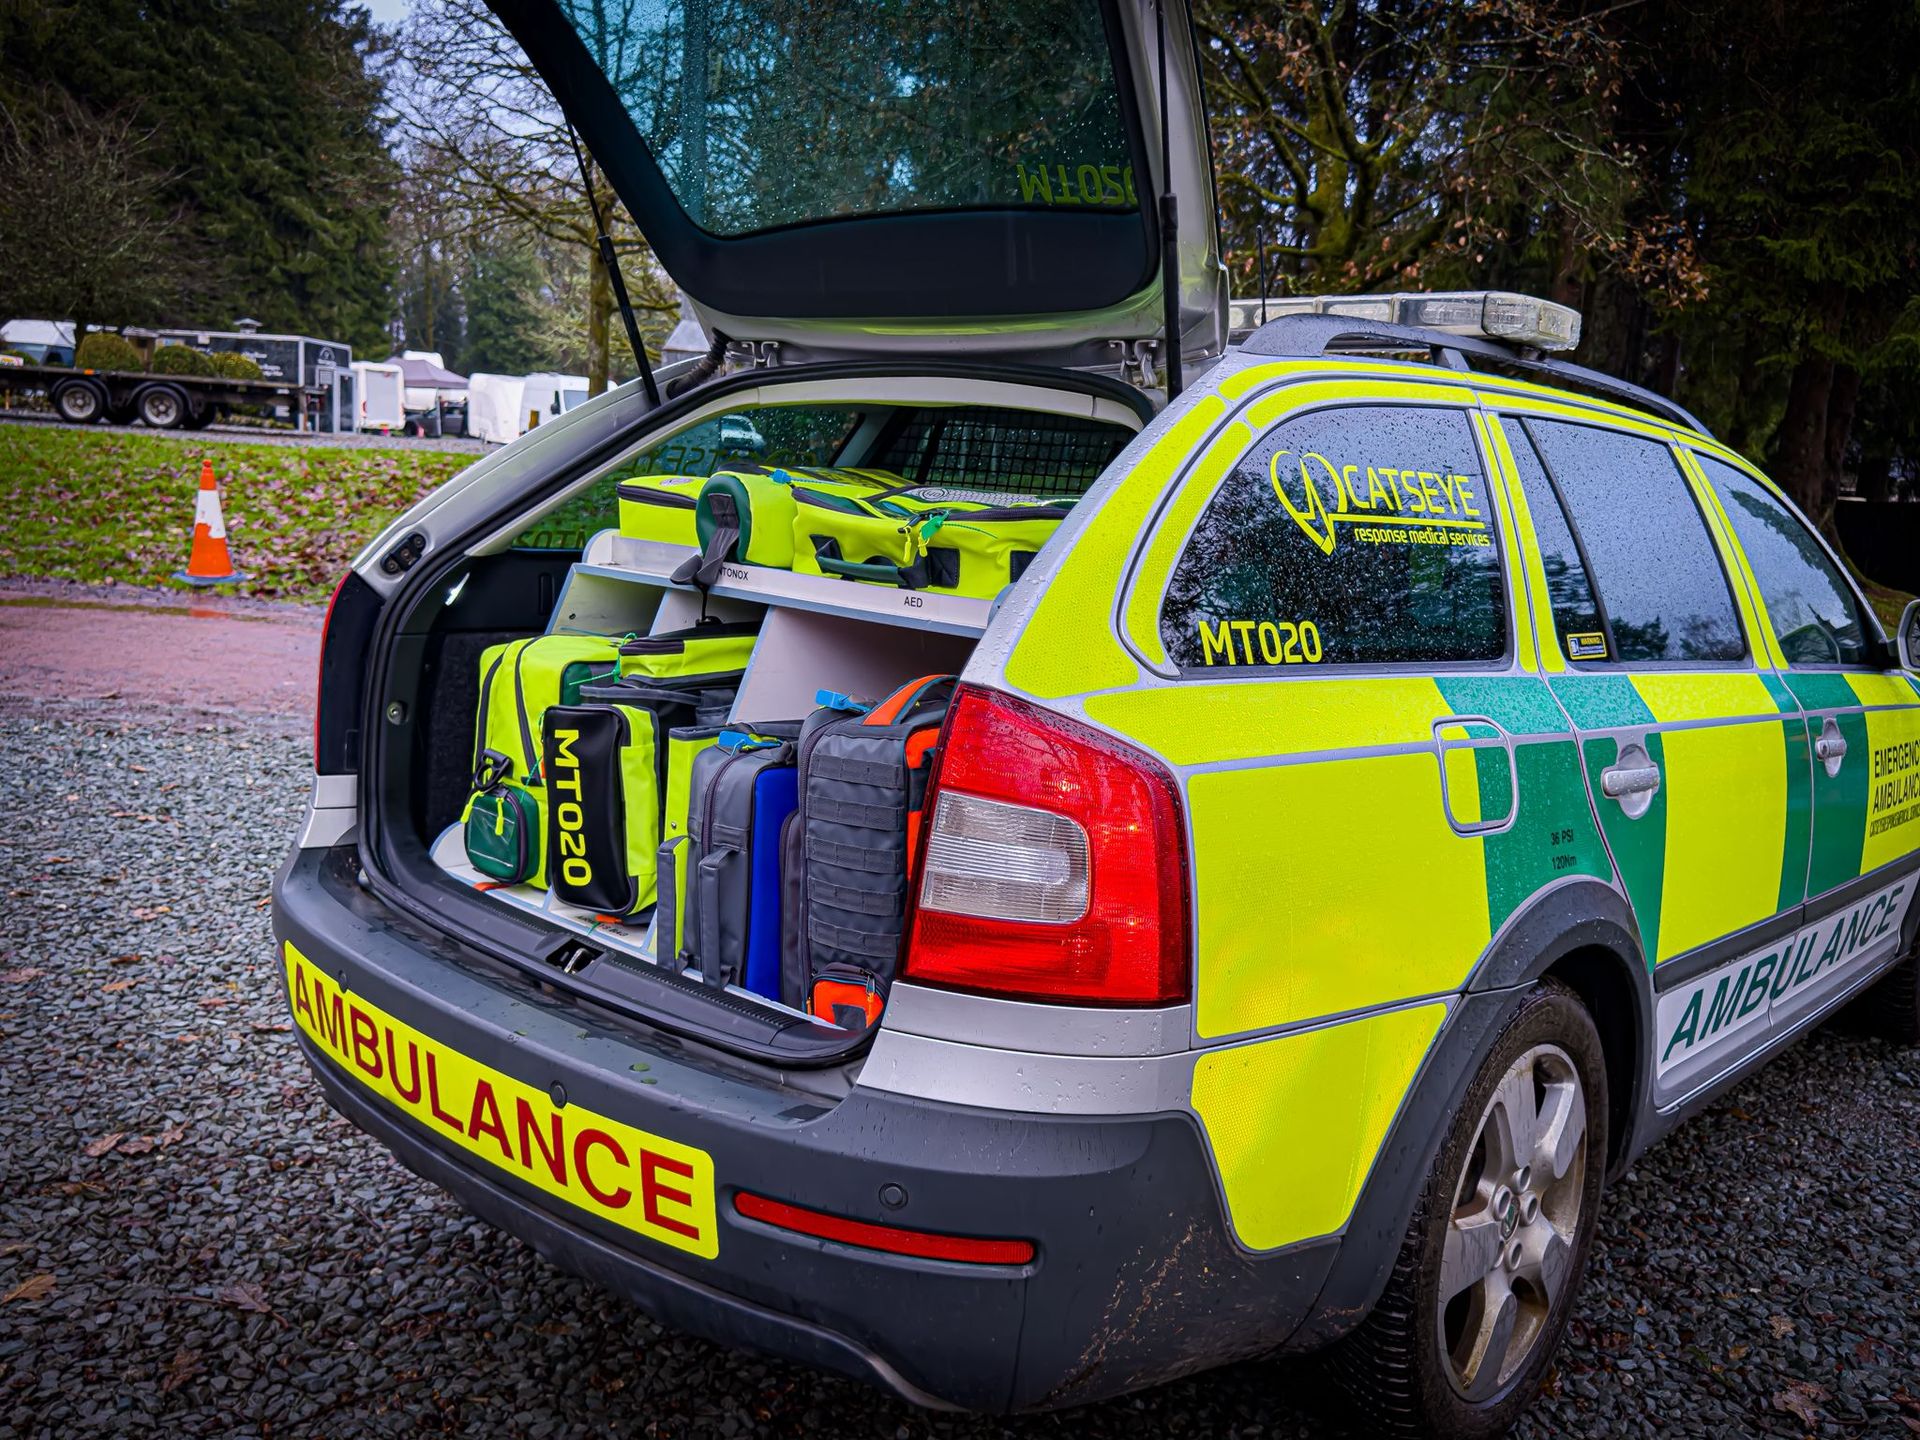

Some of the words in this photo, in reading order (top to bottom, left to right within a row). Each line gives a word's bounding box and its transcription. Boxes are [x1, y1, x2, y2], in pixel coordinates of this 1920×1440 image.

[1343, 465, 1480, 516] CATSEYE
[1354, 527, 1408, 546] response
[1409, 527, 1449, 545] medical
[1449, 530, 1490, 547] services
[718, 566, 749, 581] NTONOX
[903, 596, 923, 608] AED
[1199, 620, 1322, 666] MT020
[1874, 739, 1920, 779] EMERGENC
[554, 729, 592, 887] MT020
[1872, 772, 1920, 815] AMBULANC
[1561, 828, 1574, 843] PSI
[1662, 884, 1905, 1064] AMBULANCE
[295, 962, 700, 1241] AMBULANCE
